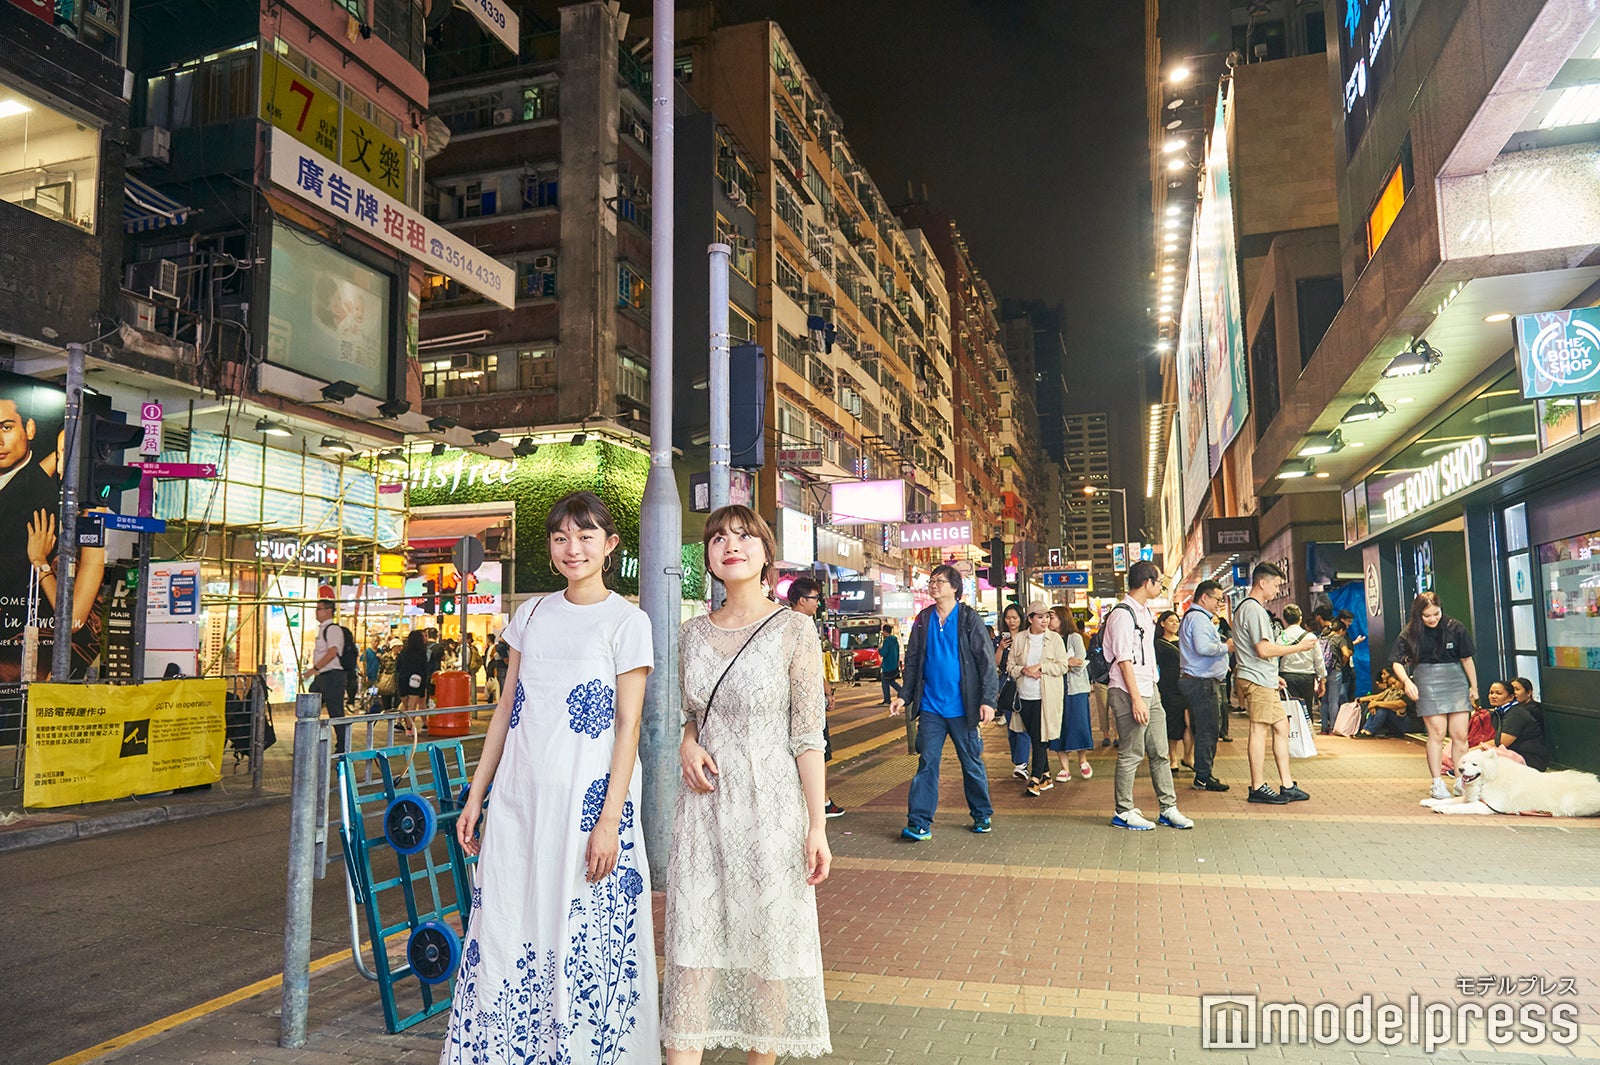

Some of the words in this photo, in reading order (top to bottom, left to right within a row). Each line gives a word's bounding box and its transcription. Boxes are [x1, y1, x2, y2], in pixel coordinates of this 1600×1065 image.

[475, 264, 501, 290] 4339
[1554, 338, 1582, 350] THE
[1548, 346, 1592, 362] BODY
[1550, 359, 1592, 374] SHOP
[1383, 482, 1408, 524] THE
[1406, 461, 1440, 513] BODY
[1441, 436, 1486, 496] SHOP
[901, 525, 970, 543] LANEIGE
[255, 539, 327, 563] swatch
